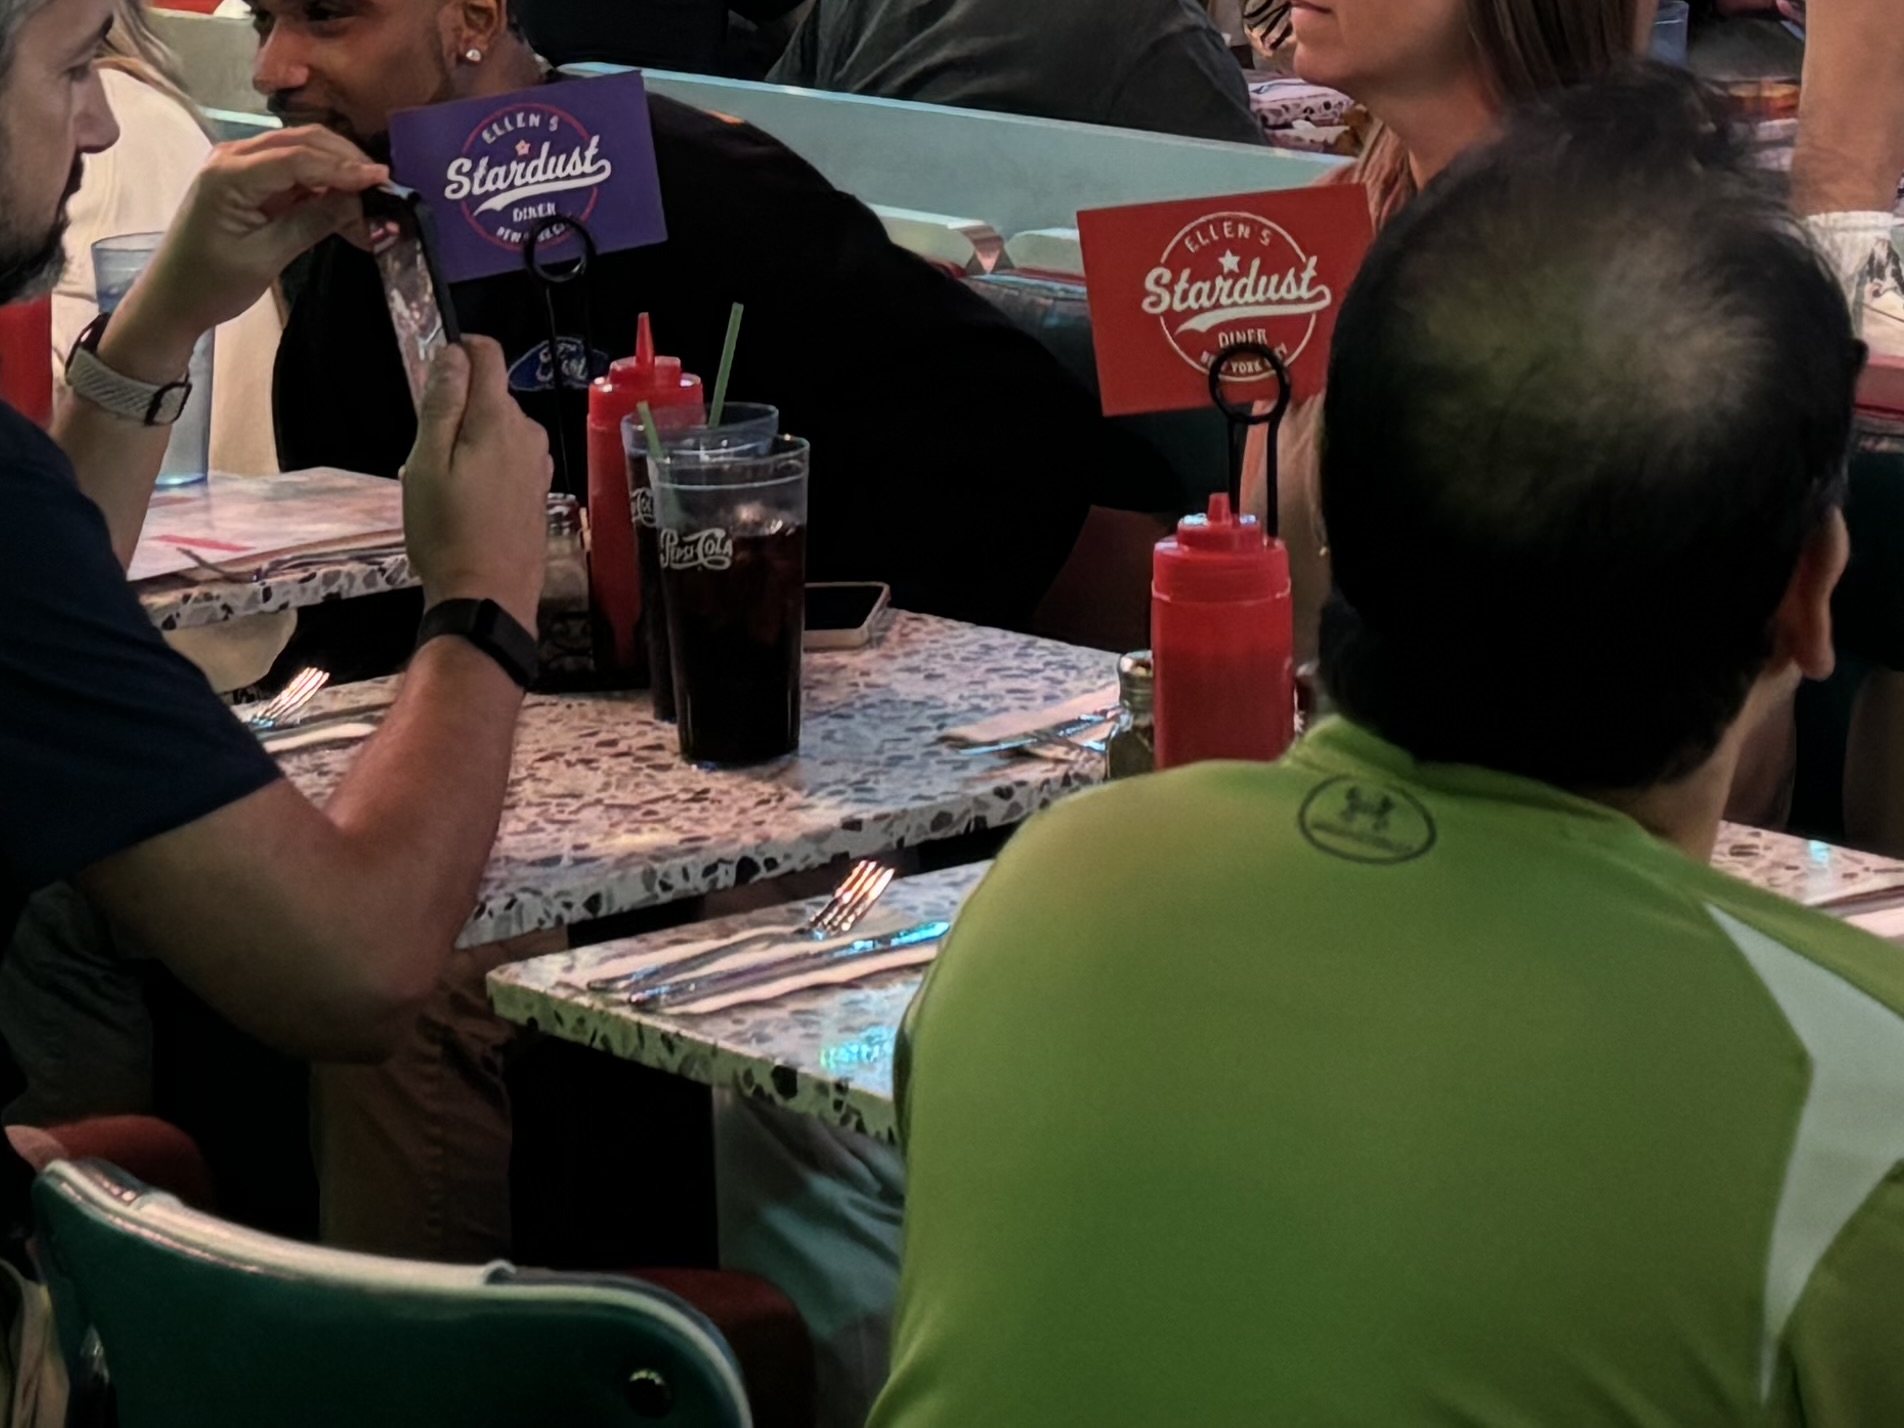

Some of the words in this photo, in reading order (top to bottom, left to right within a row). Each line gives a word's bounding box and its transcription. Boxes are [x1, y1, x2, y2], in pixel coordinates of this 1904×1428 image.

[444, 135, 612, 200] Stardust
[512, 201, 557, 223] DINER
[1185, 220, 1273, 253] ELLEN'S
[1141, 255, 1332, 314] Stardust
[1231, 360, 1262, 374] YORK
